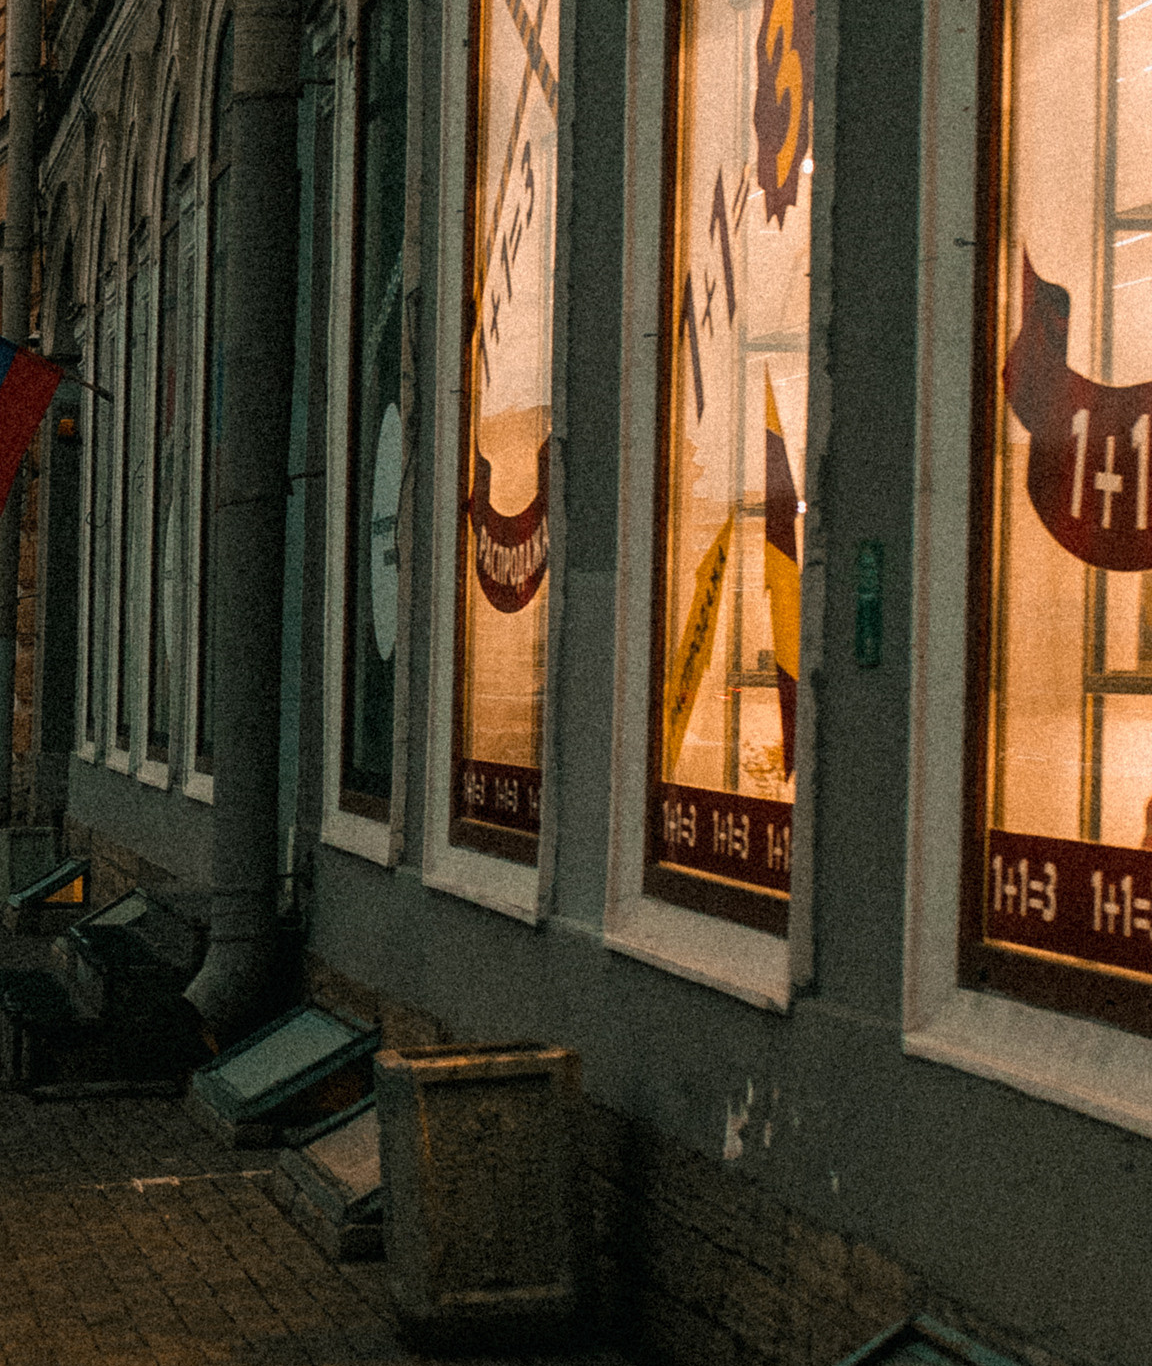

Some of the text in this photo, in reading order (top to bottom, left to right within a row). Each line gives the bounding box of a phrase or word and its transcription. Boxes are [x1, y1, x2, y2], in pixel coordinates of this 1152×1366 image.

[478, 515, 550, 595] РАСПРОДАЖА
[663, 800, 698, 848] 1+1=3
[712, 810, 751, 861] 1+1=3
[992, 854, 1152, 941] 1+1=3 1+1=
